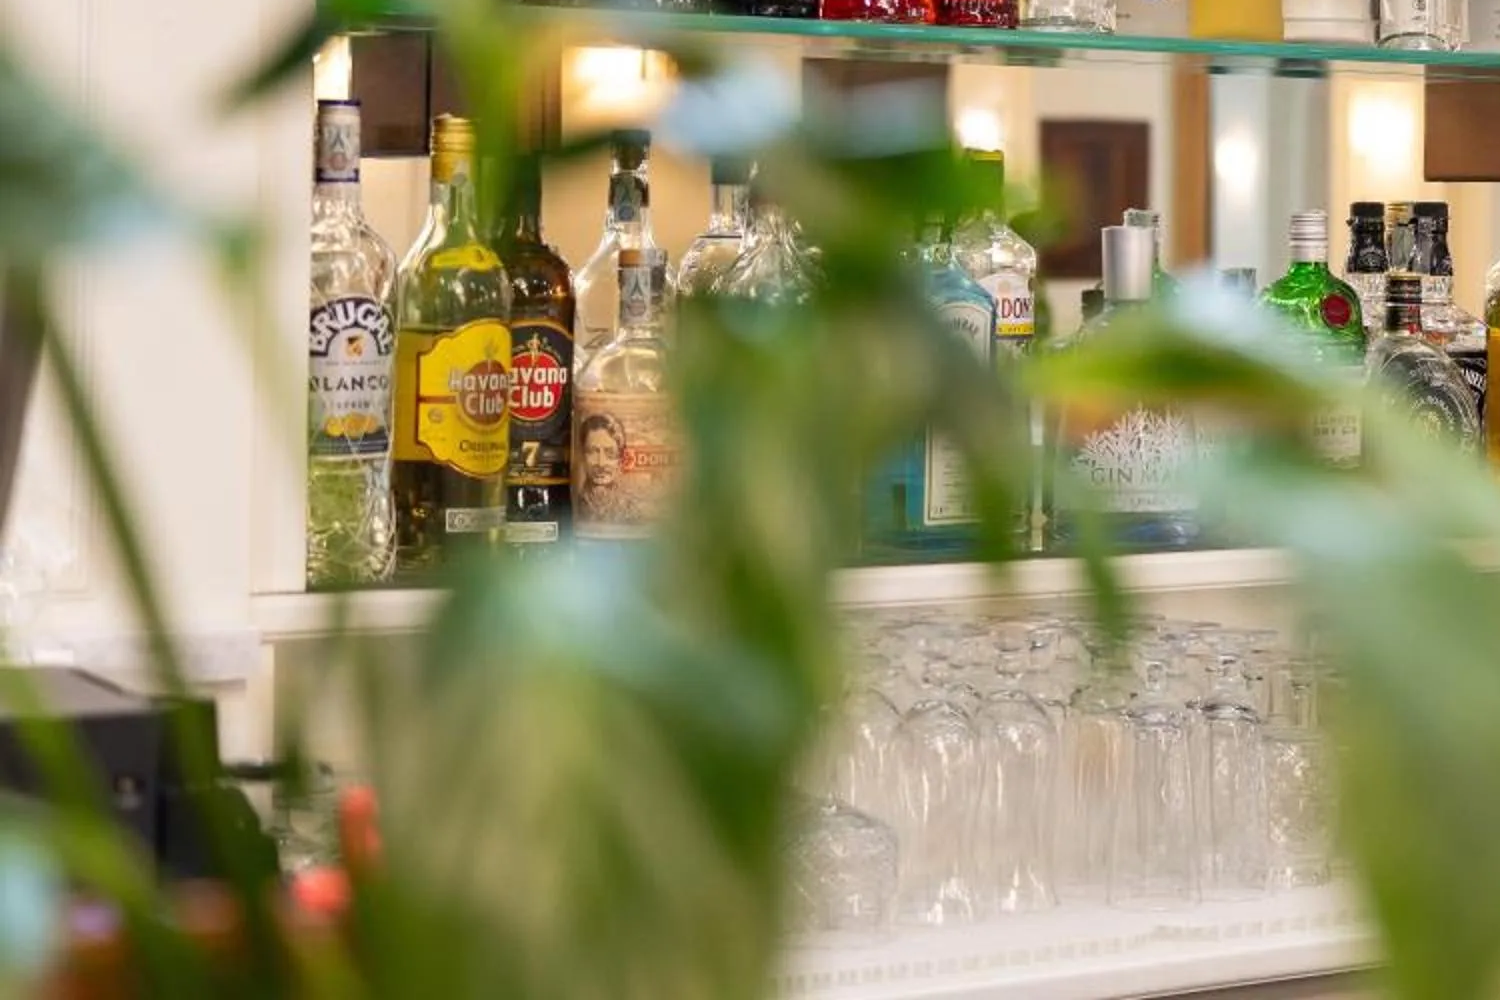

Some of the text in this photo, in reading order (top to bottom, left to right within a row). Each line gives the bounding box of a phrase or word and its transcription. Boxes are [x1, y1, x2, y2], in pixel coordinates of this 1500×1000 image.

[451, 367, 508, 391] Havan
[510, 366, 568, 385] avana
[464, 391, 507, 414] Club
[509, 385, 555, 408] Club
[522, 441, 541, 468] 7
